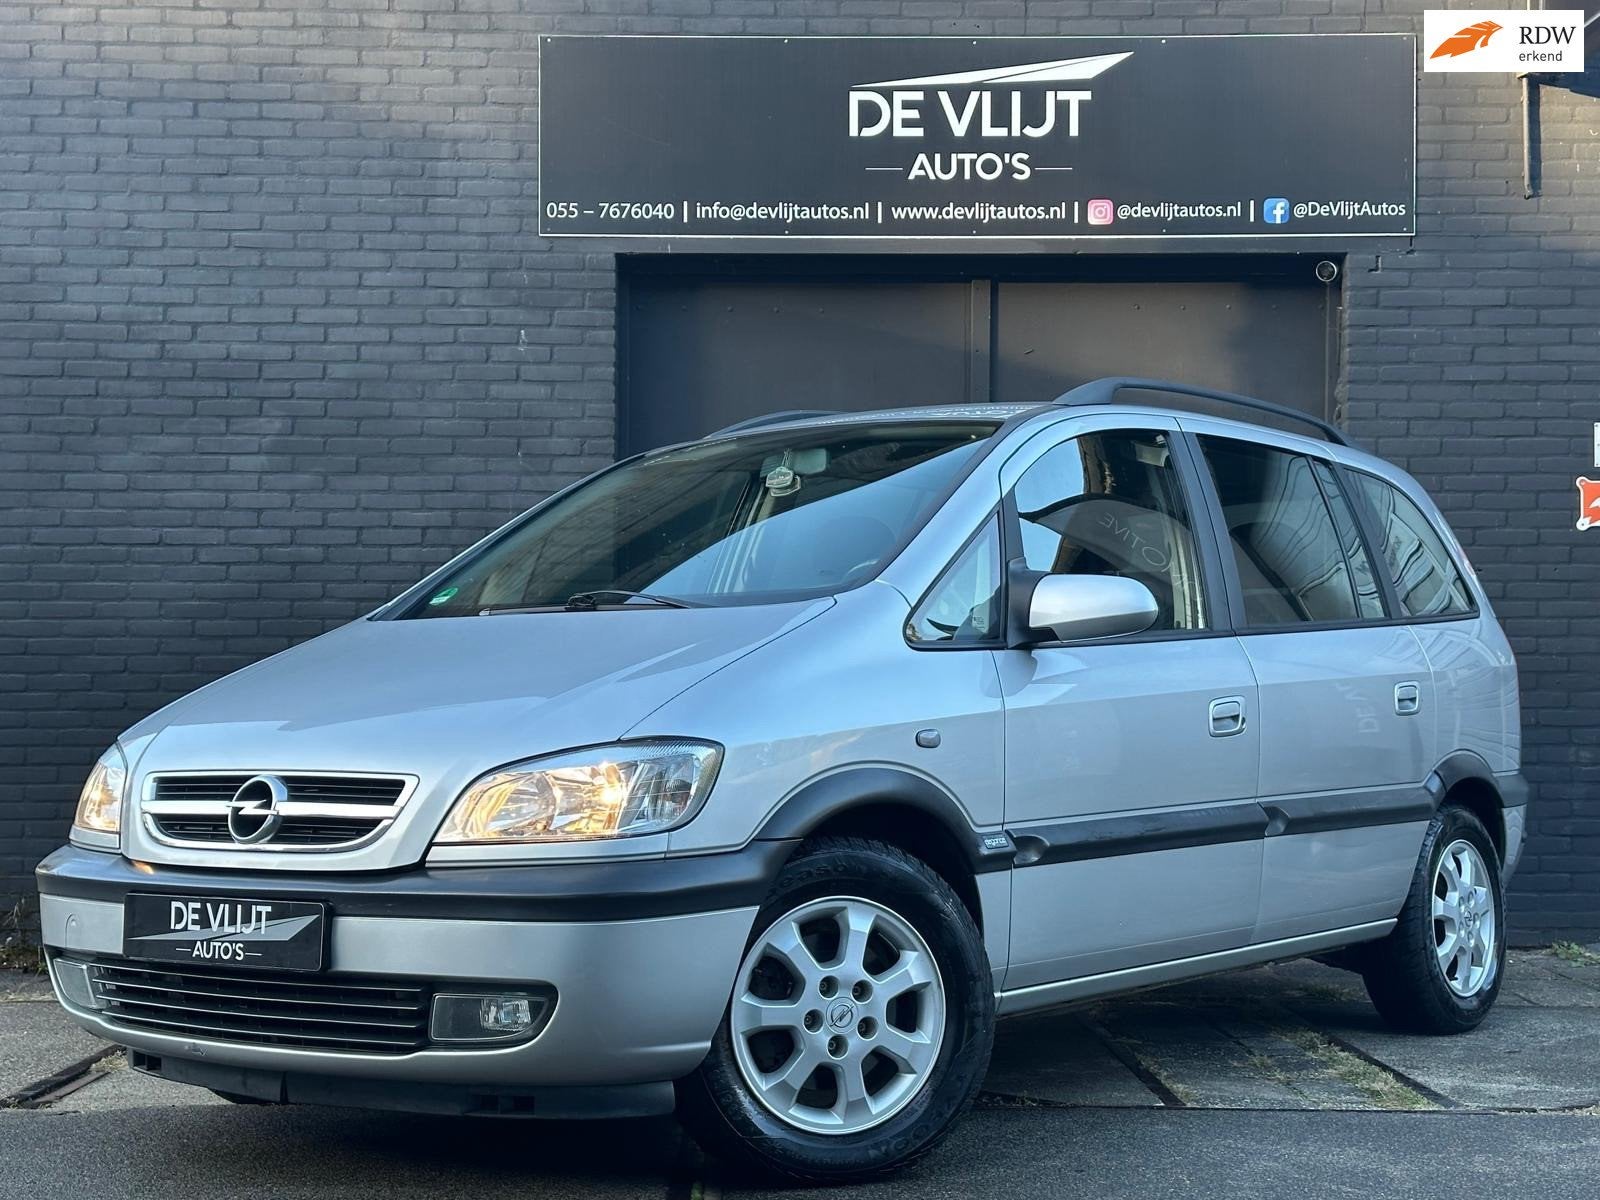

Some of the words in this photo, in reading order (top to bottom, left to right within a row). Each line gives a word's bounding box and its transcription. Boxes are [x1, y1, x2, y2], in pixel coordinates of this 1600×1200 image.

[849, 90, 925, 137] DE
[937, 90, 1092, 138] VLIJT
[907, 152, 1032, 181] AUTO'S
[546, 202, 579, 219] 055
[598, 202, 675, 219] 7676040
[696, 201, 870, 223] info@devlijtautos.nl
[891, 201, 1066, 223] www.devlijtautos.nl
[1116, 201, 1242, 222] @devlijtautos.nl
[1293, 201, 1406, 220] @DeVlijtAutos
[170, 901, 201, 931] DE
[206, 903, 272, 935] VLIJT
[192, 940, 244, 961] AUTO'S
